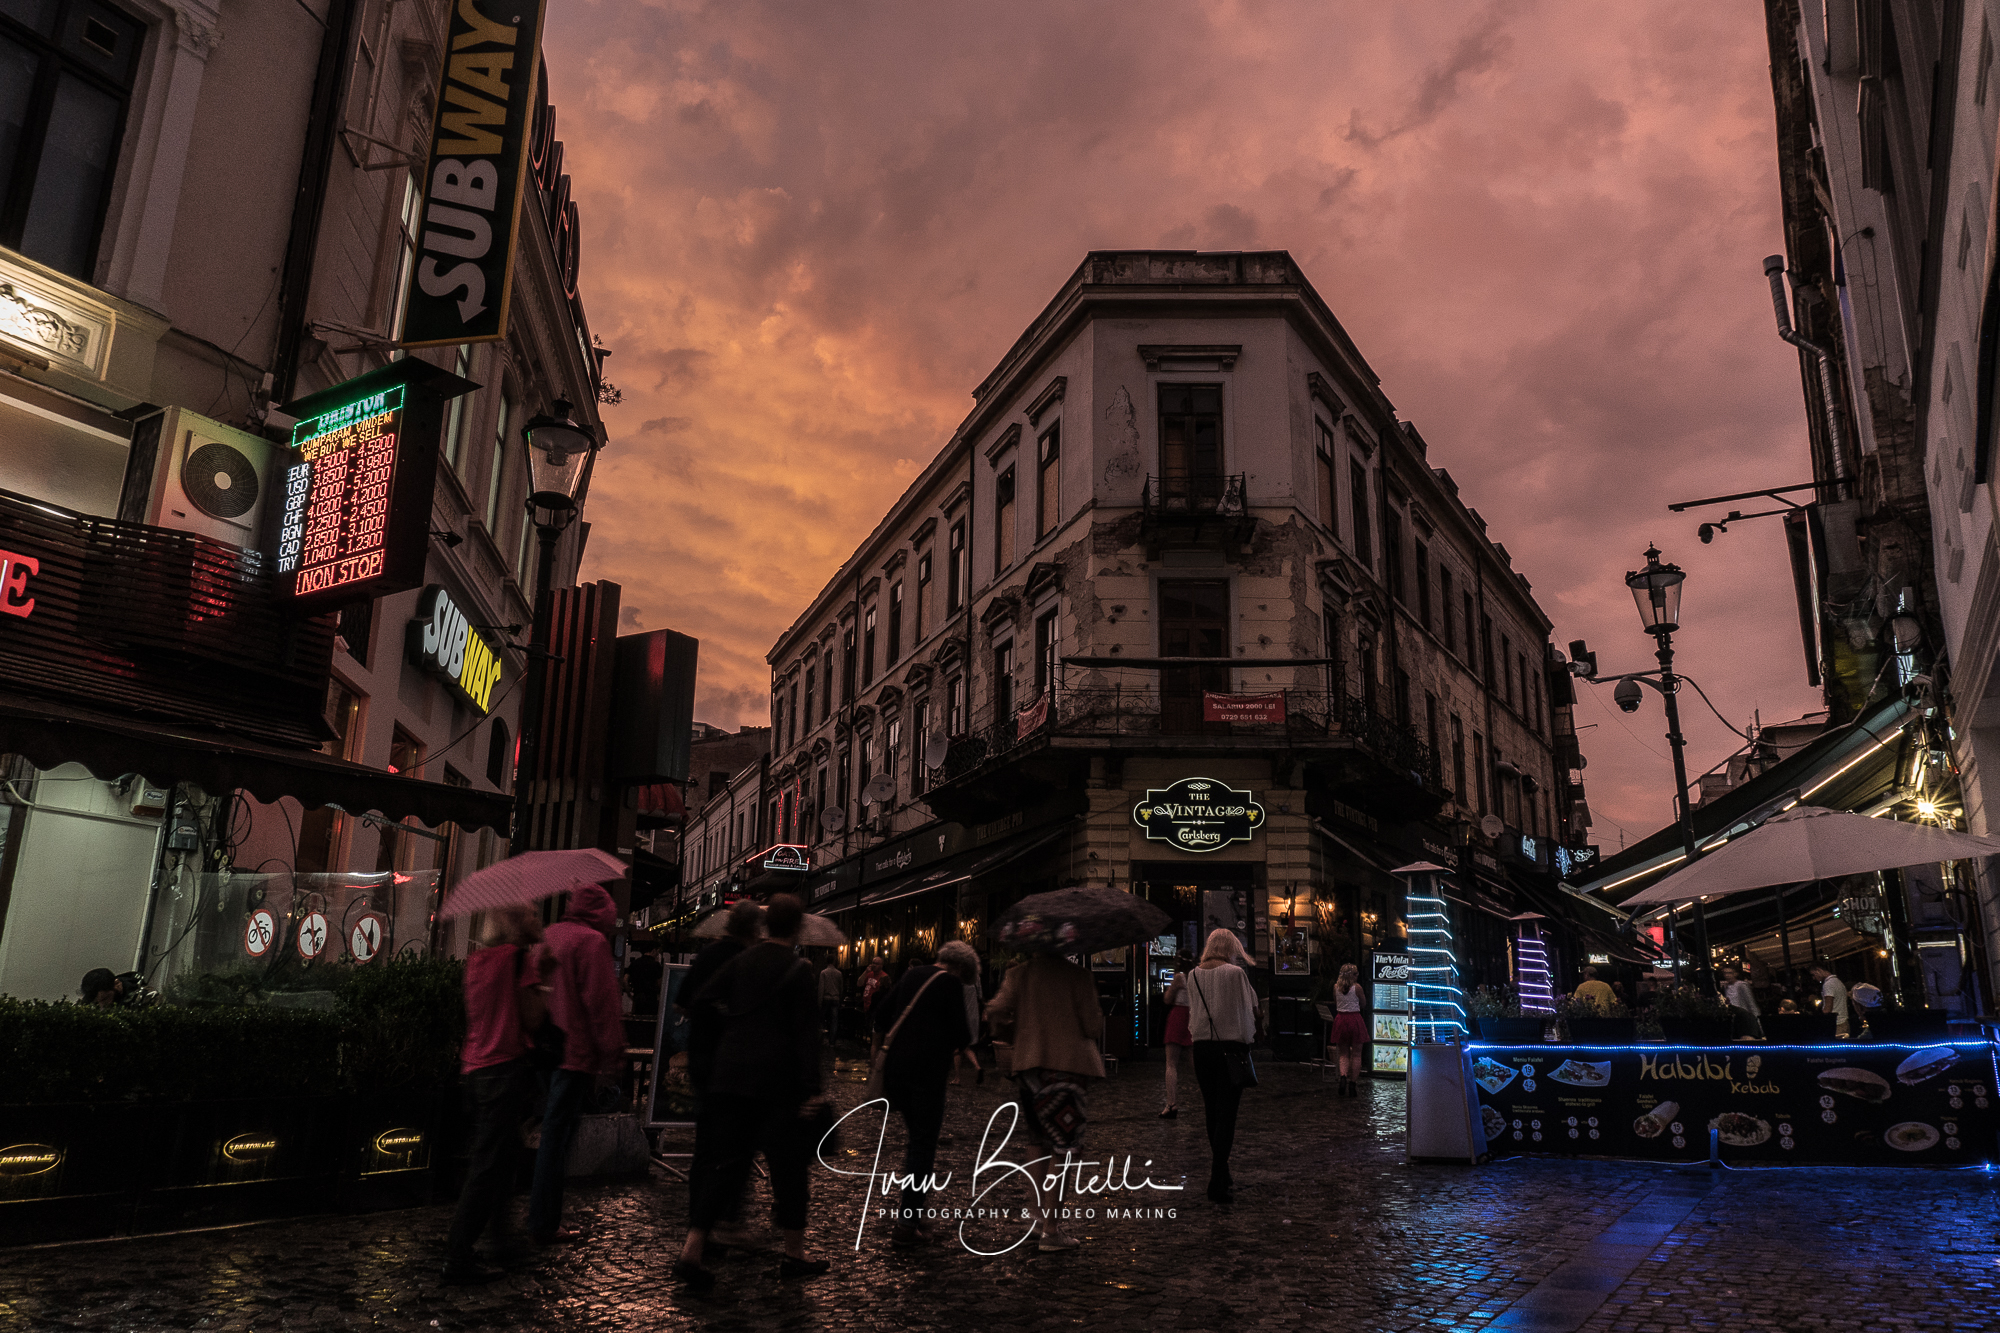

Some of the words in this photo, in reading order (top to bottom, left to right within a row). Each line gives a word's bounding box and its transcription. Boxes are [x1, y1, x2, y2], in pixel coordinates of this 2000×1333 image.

[418, 0, 518, 324] SUBWAY
[356, 411, 393, 433] VINDEM
[304, 448, 318, 461] WE
[320, 440, 339, 457] BUY
[342, 434, 357, 448] WE
[358, 426, 383, 443] SELL
[289, 463, 310, 482] EUR
[314, 450, 349, 473] 4.5000
[284, 509, 303, 526] CHF
[307, 497, 342, 519] 4.0200
[351, 482, 388, 505] 4.2000
[286, 493, 306, 511] GBP
[311, 481, 345, 503] 4.9000
[353, 466, 391, 490] 5.2000
[288, 478, 308, 496] USD
[279, 540, 299, 558] CAD
[304, 528, 339, 551] 2.8500
[348, 514, 385, 538] 3.1000
[281, 523, 302, 542] BGN
[306, 511, 341, 535] 2.2500
[350, 498, 387, 522] 2.4500
[278, 555, 299, 573] TRY
[302, 544, 337, 566] 1.0400
[346, 531, 383, 554] 1.2300
[301, 565, 335, 594] NON
[338, 554, 381, 584] STOP
[423, 589, 501, 714] SUBWAY
[1163, 803, 1236, 819] VINTAGE
[1178, 827, 1221, 846] Carlsberg
[1639, 1053, 1734, 1081] Habibi
